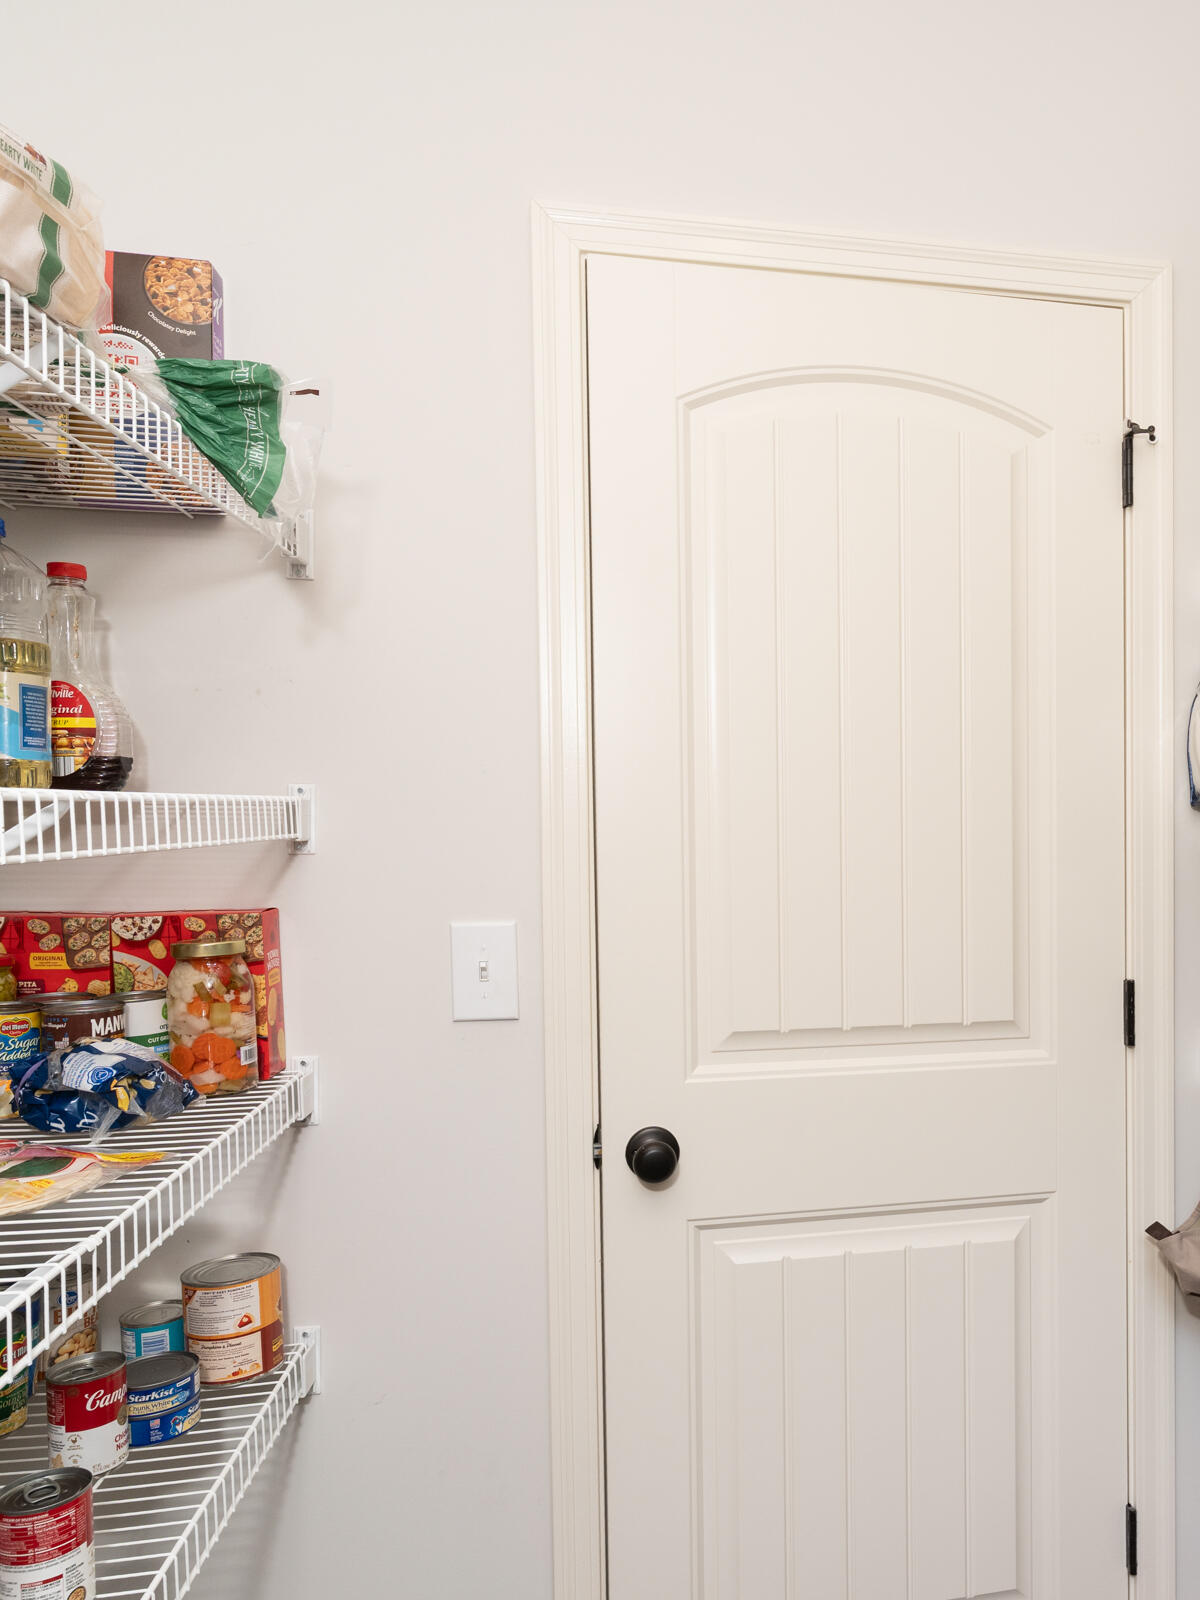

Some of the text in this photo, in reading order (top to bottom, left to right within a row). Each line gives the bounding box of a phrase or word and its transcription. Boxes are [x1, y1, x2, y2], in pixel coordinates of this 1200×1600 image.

[101, 323, 142, 340] deliciously
[12, 1022, 30, 1031] Monte
[5, 1036, 40, 1052] Sugar
[128, 1386, 174, 1403] StarKist
[128, 1400, 171, 1412] Chunk White
